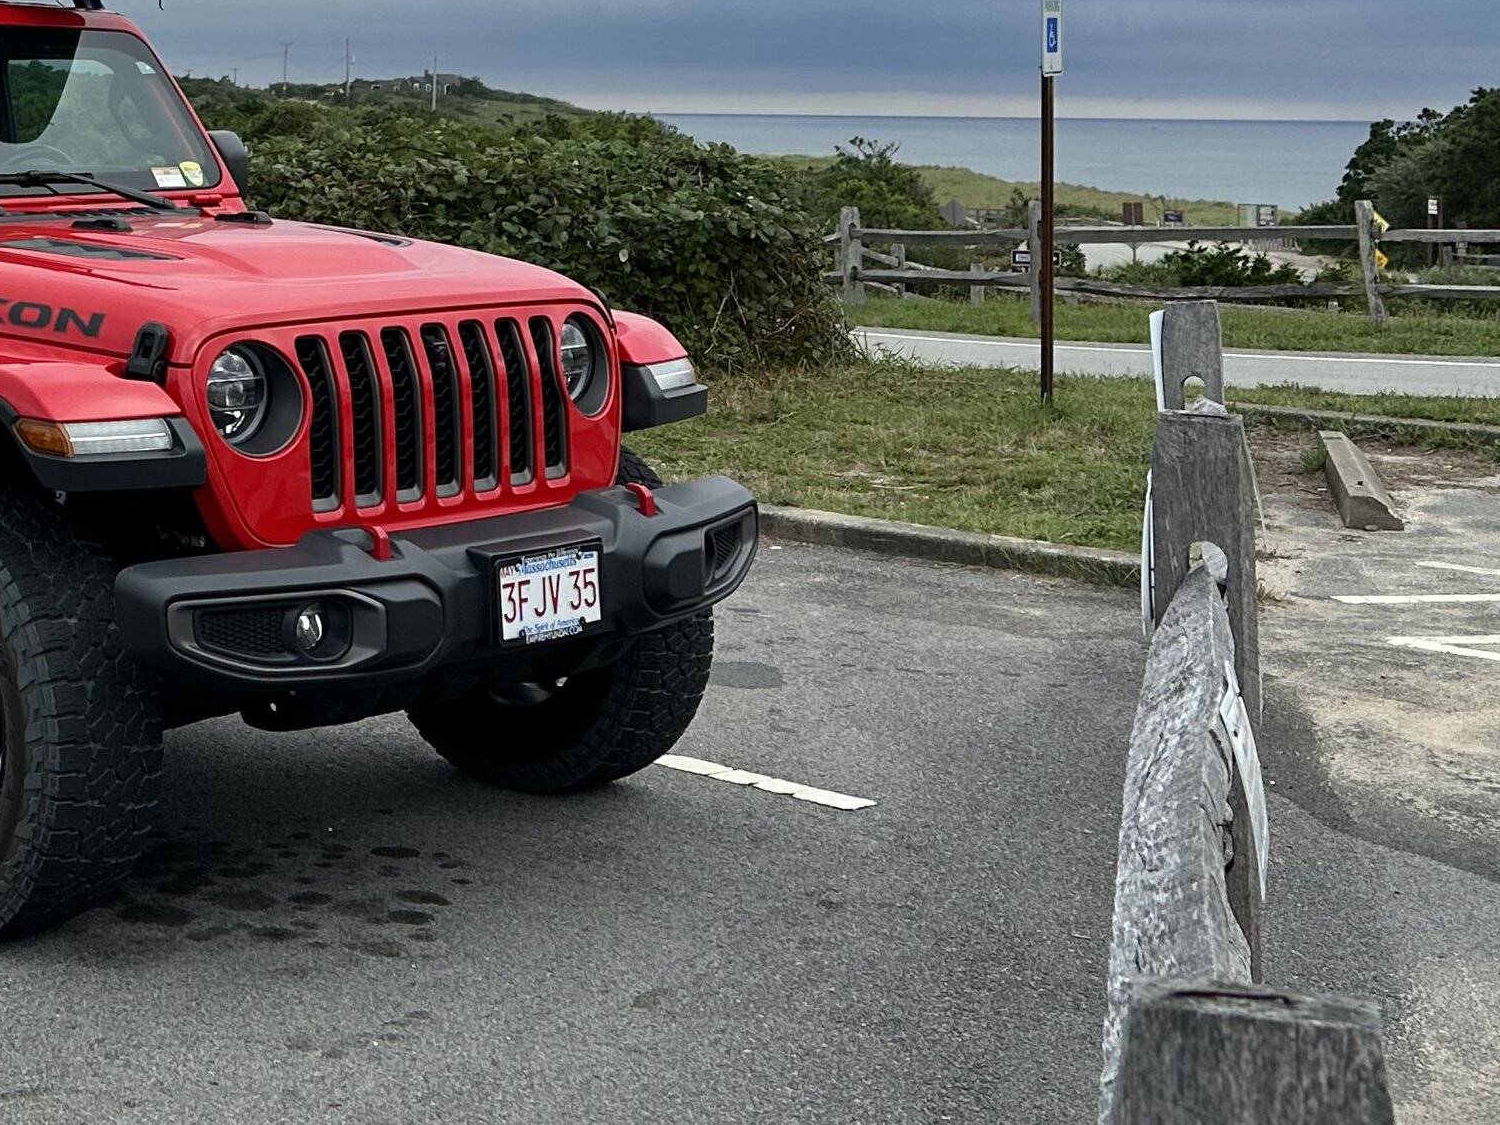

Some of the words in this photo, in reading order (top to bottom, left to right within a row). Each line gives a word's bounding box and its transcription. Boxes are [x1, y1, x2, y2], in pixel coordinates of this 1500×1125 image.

[500, 564, 515, 579] MAY
[520, 556, 577, 575] Massachusetts
[502, 579, 531, 624] 3F
[534, 573, 561, 618] JV
[568, 567, 597, 611] 35
[534, 621, 549, 635] Spirit
[549, 619, 556, 630] of
